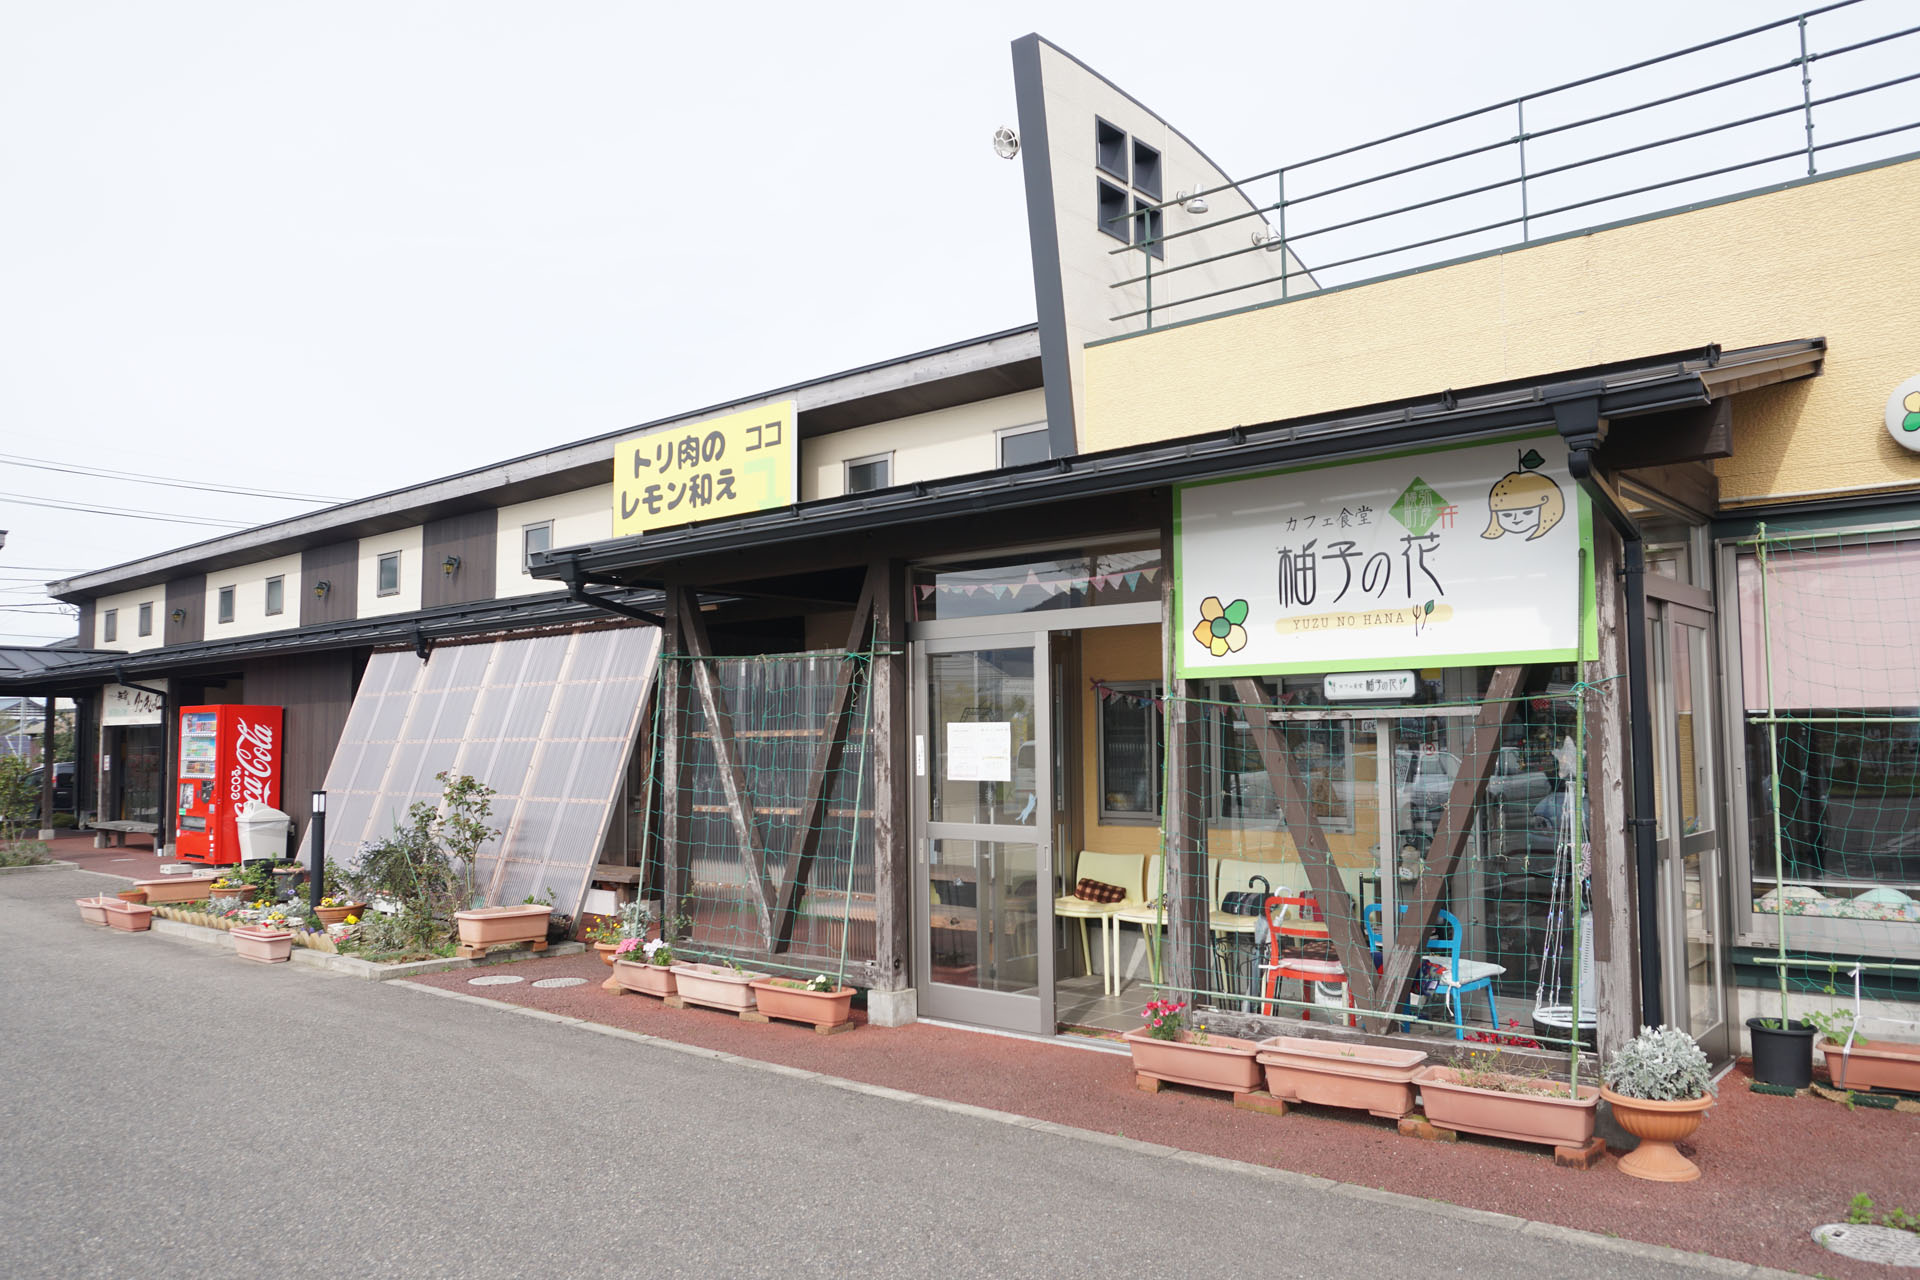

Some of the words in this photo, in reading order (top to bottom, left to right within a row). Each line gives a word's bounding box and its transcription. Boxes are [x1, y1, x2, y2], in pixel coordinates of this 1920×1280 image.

[633, 430, 726, 479] トリ肉の
[745, 420, 782, 452] ココ
[621, 468, 737, 520] レモン和え
[1285, 504, 1373, 532] カフェ食堂
[1276, 533, 1446, 609] 柚子の花
[1292, 617, 1329, 630] YUZU
[1337, 615, 1356, 627] NO
[1363, 612, 1405, 625] HANA
[1363, 720, 1377, 731] OPE
[234, 716, 273, 817] ca-Cola
